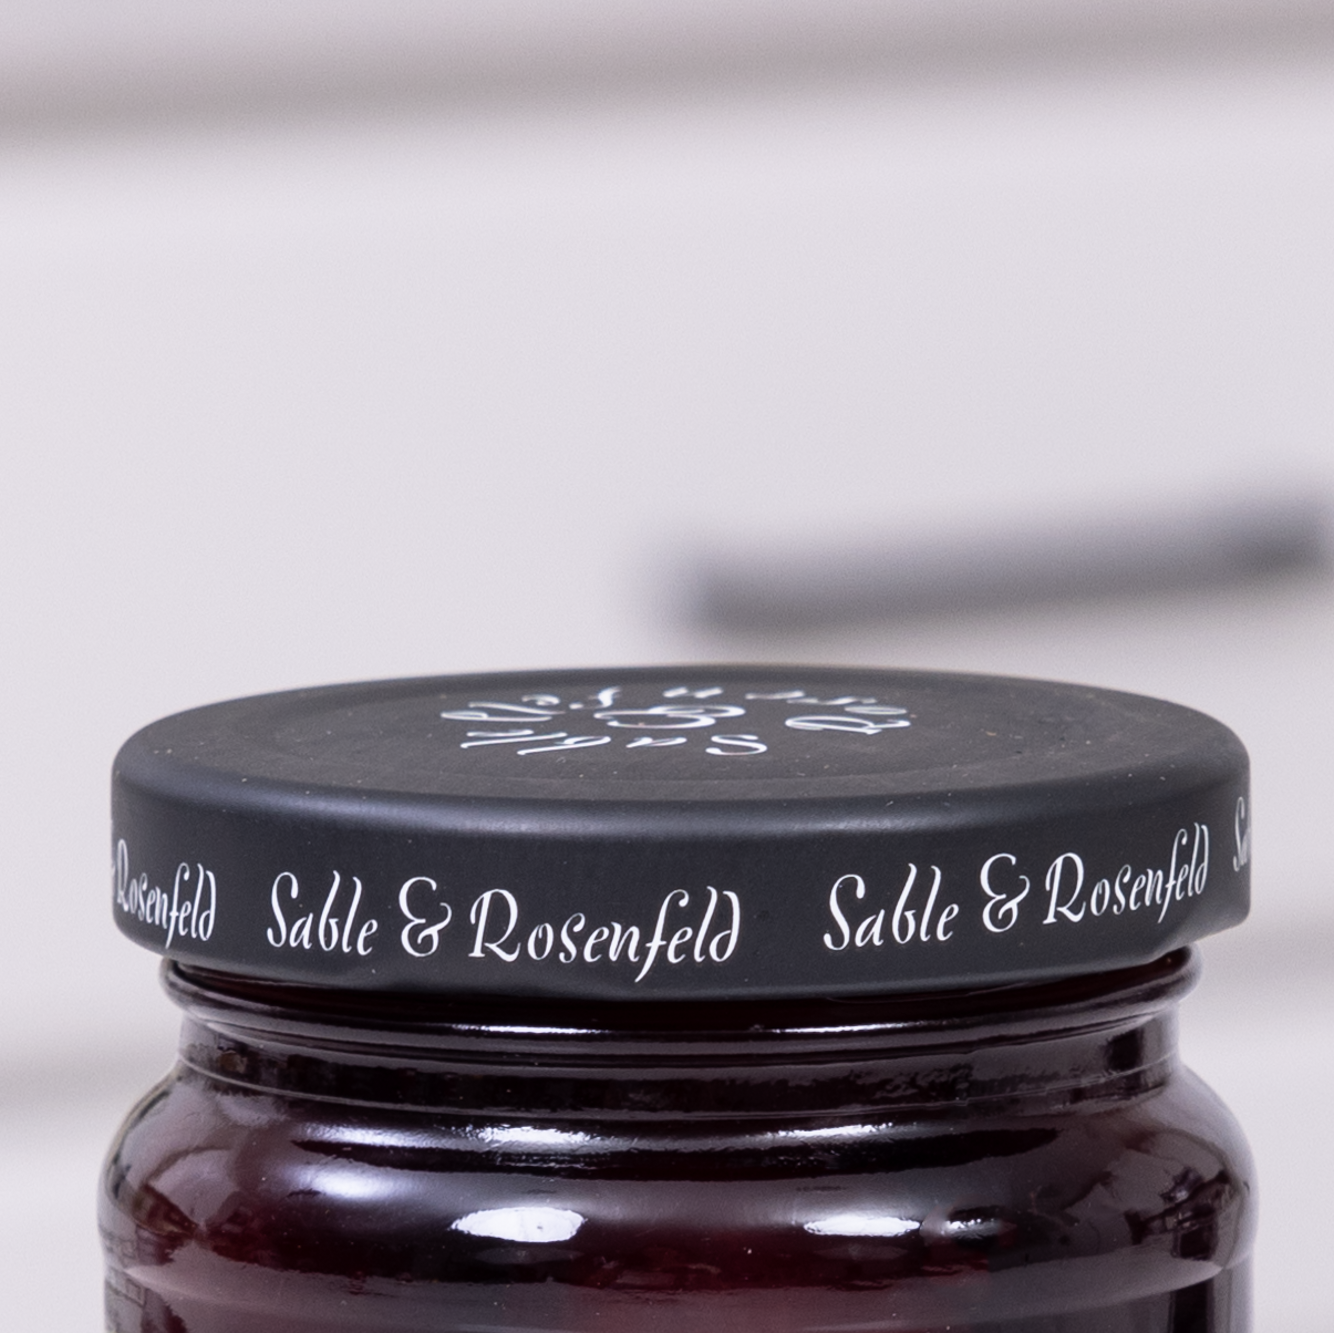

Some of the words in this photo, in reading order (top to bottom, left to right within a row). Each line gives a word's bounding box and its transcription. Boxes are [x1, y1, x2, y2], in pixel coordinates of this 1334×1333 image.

[116, 838, 217, 949] Rosenfeld
[265, 870, 379, 956] Sable
[398, 876, 453, 958] &
[468, 886, 742, 983] Rosenfeld
[823, 862, 960, 950] Sable
[980, 853, 1031, 933] &
[1042, 822, 1210, 925] Rosenfeld
